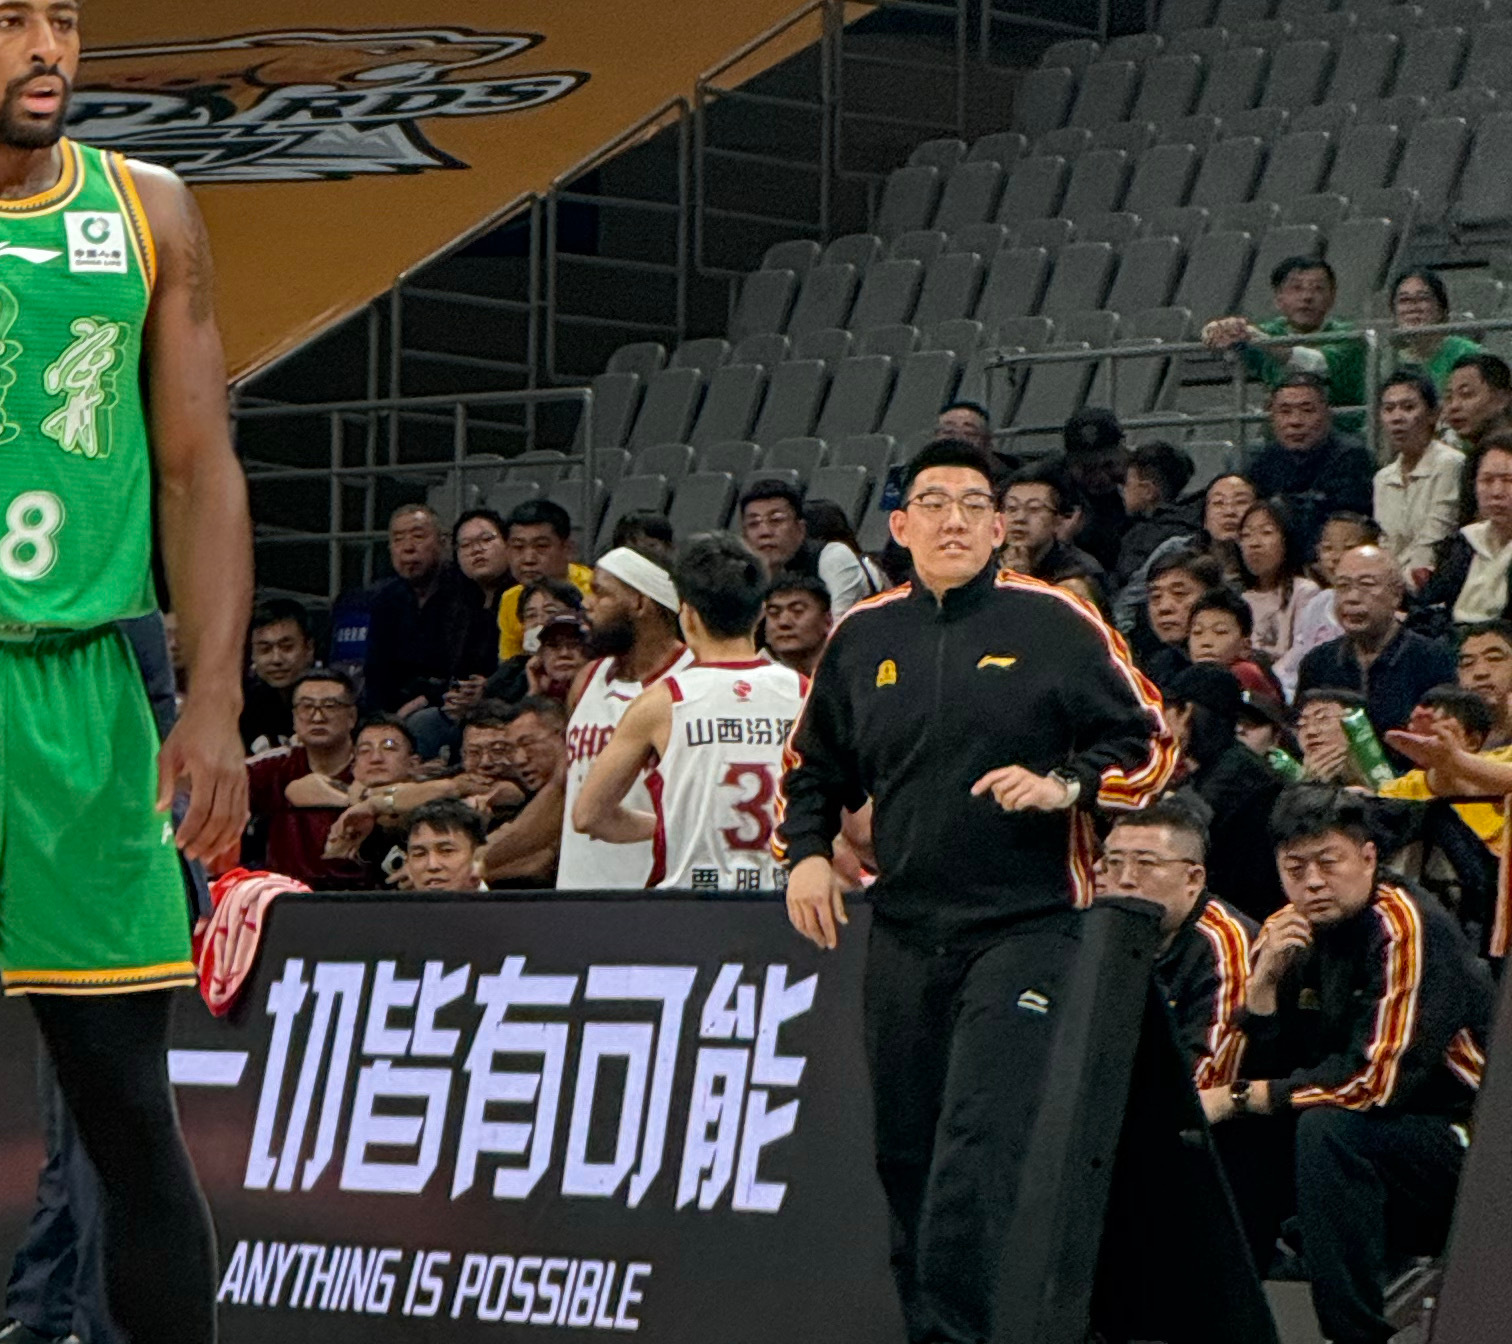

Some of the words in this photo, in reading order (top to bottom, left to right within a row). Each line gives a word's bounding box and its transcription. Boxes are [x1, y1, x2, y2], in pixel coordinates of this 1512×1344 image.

[167, 955, 819, 1214] 一切皆有可能
[217, 1240, 403, 1315] ANYTHING
[403, 1251, 452, 1316] IS
[451, 1253, 652, 1331] POSSIBLE
